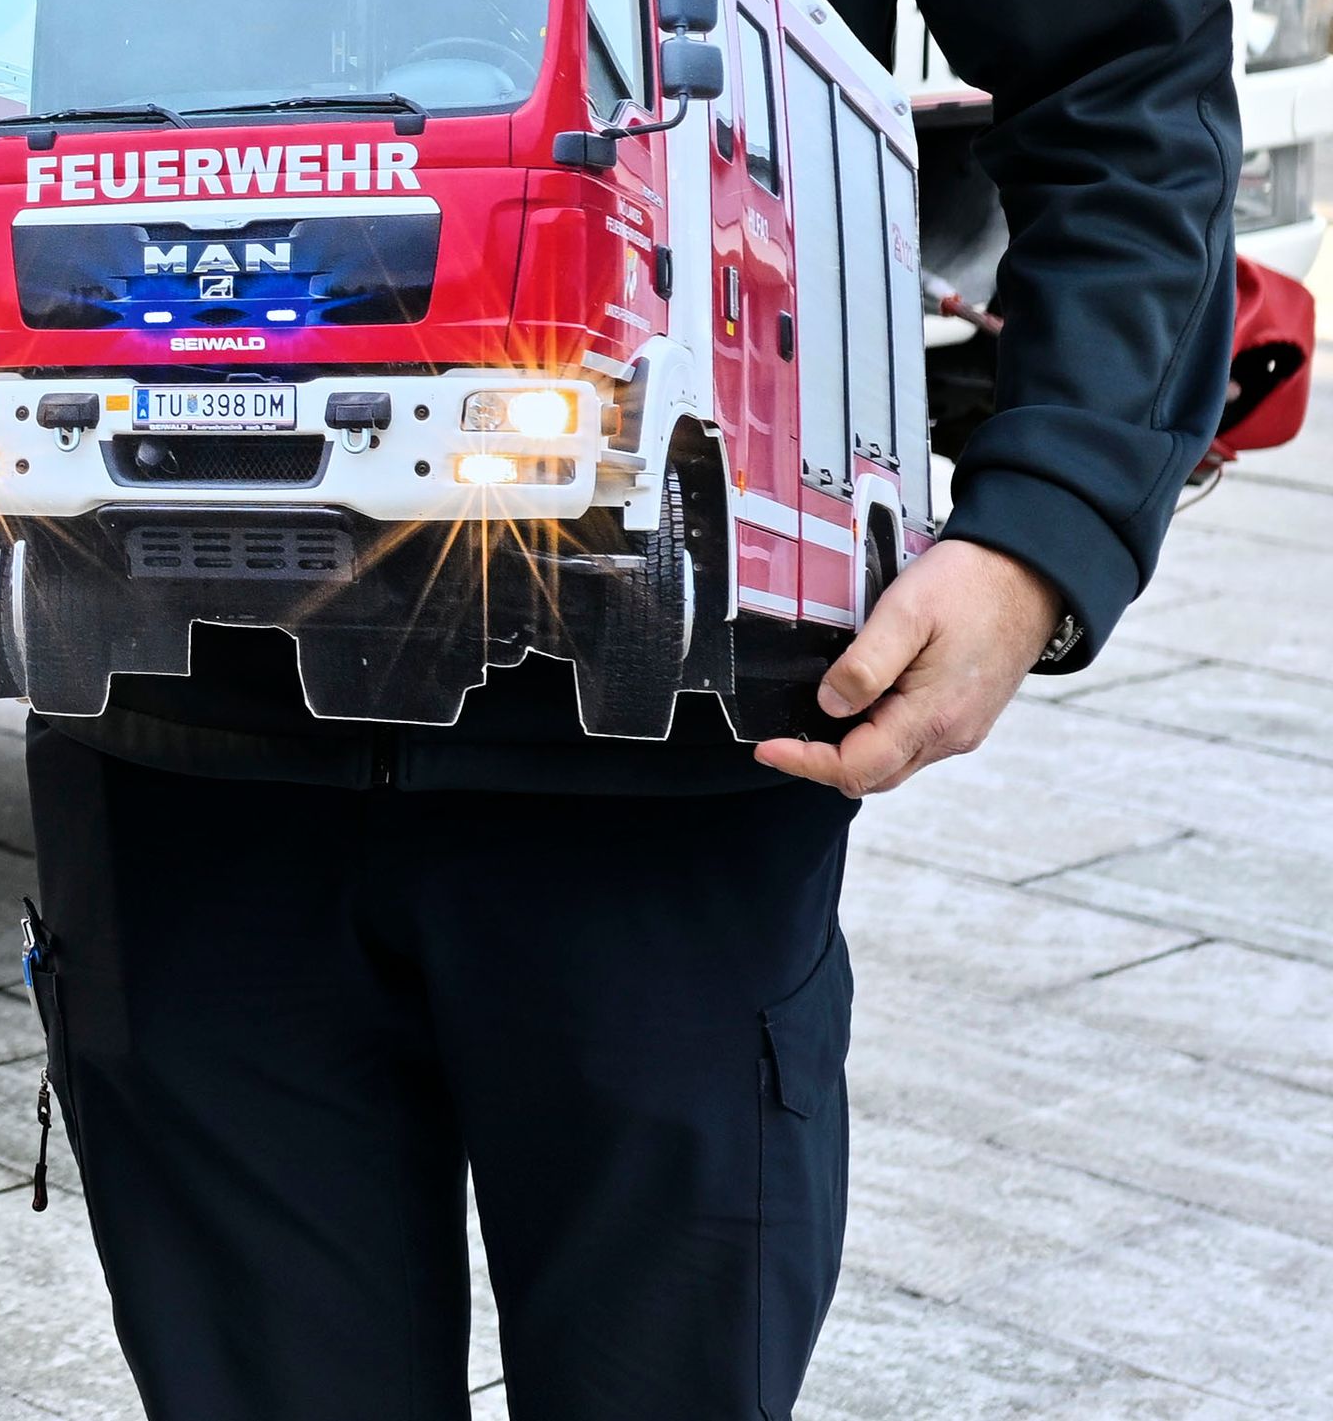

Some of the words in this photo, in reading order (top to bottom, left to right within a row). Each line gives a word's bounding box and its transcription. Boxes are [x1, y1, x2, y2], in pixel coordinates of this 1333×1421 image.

[25, 141, 422, 203] FEUERWEHR
[144, 242, 291, 274] MAN
[170, 337, 266, 351] SEIWALD
[155, 394, 182, 416] TU
[202, 394, 246, 416] 398
[254, 394, 284, 416] DM
